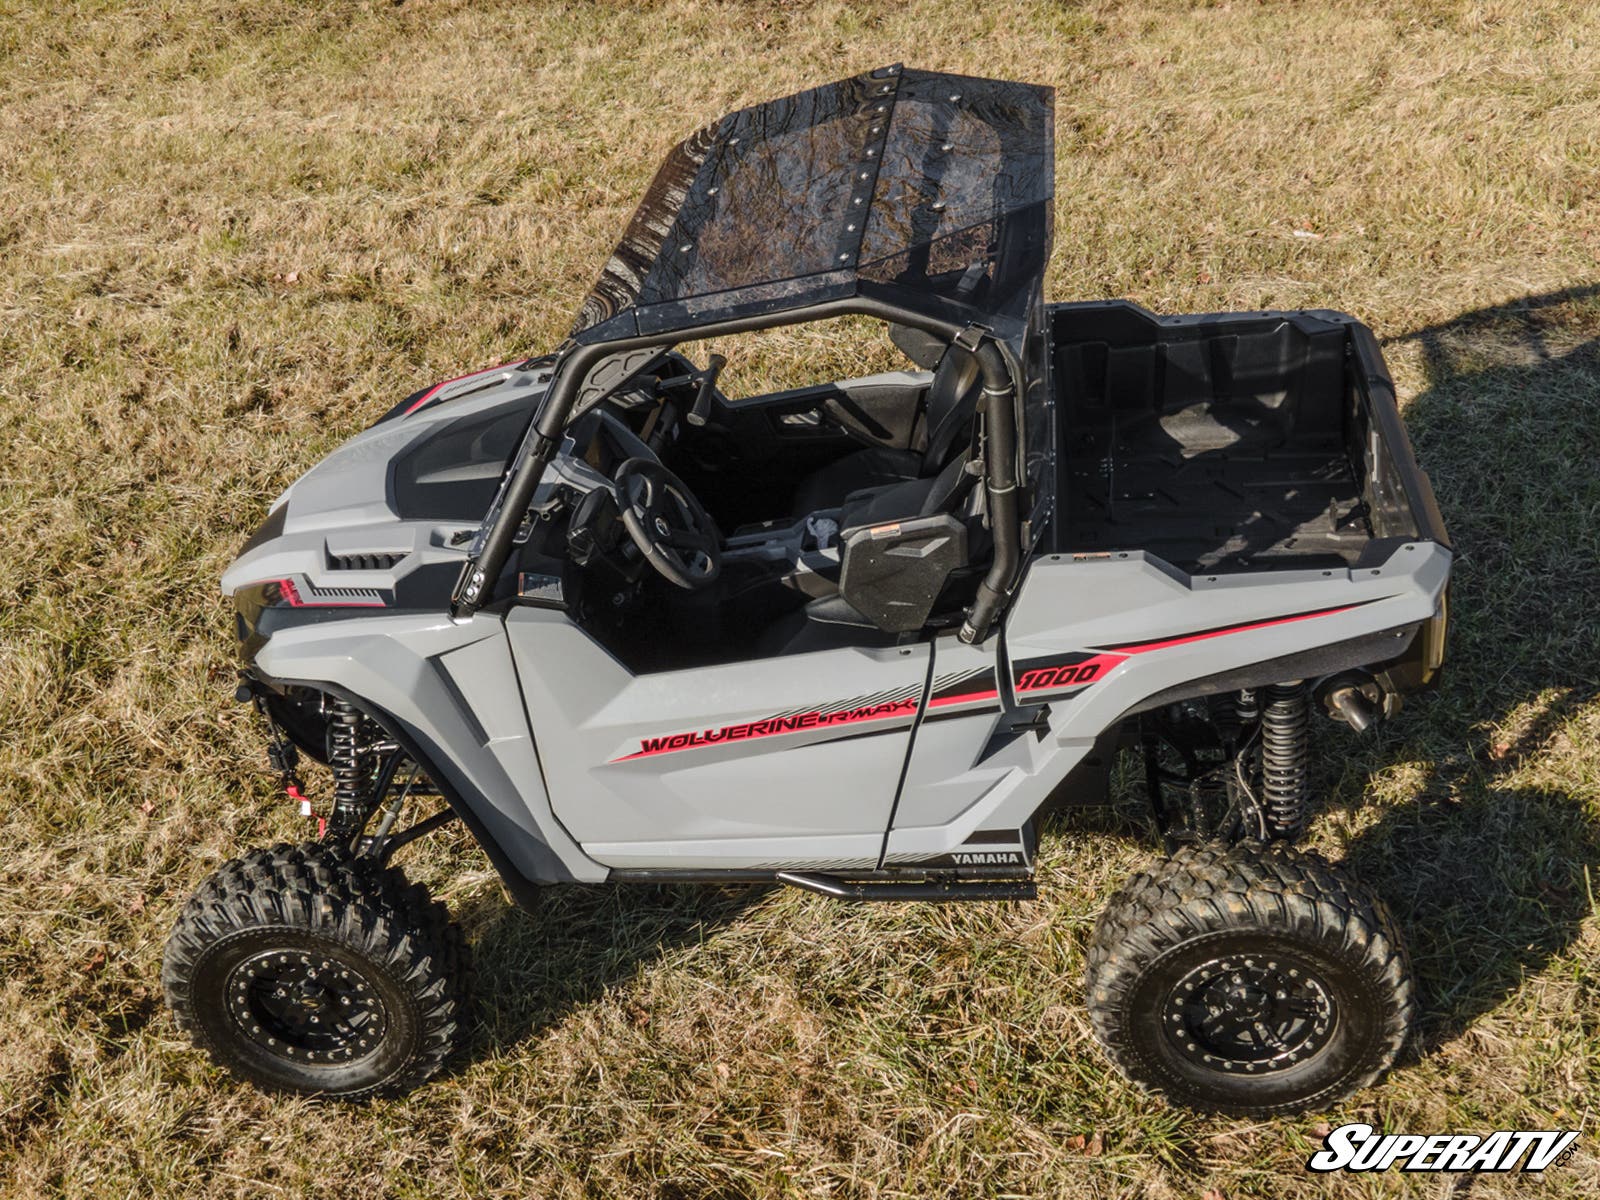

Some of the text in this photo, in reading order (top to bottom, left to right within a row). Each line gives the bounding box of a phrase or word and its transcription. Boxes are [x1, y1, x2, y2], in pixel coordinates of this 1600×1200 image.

[1020, 663, 1101, 690] 1000
[640, 712, 820, 752] WOLVERINE
[951, 853, 1019, 864] YAMAHA
